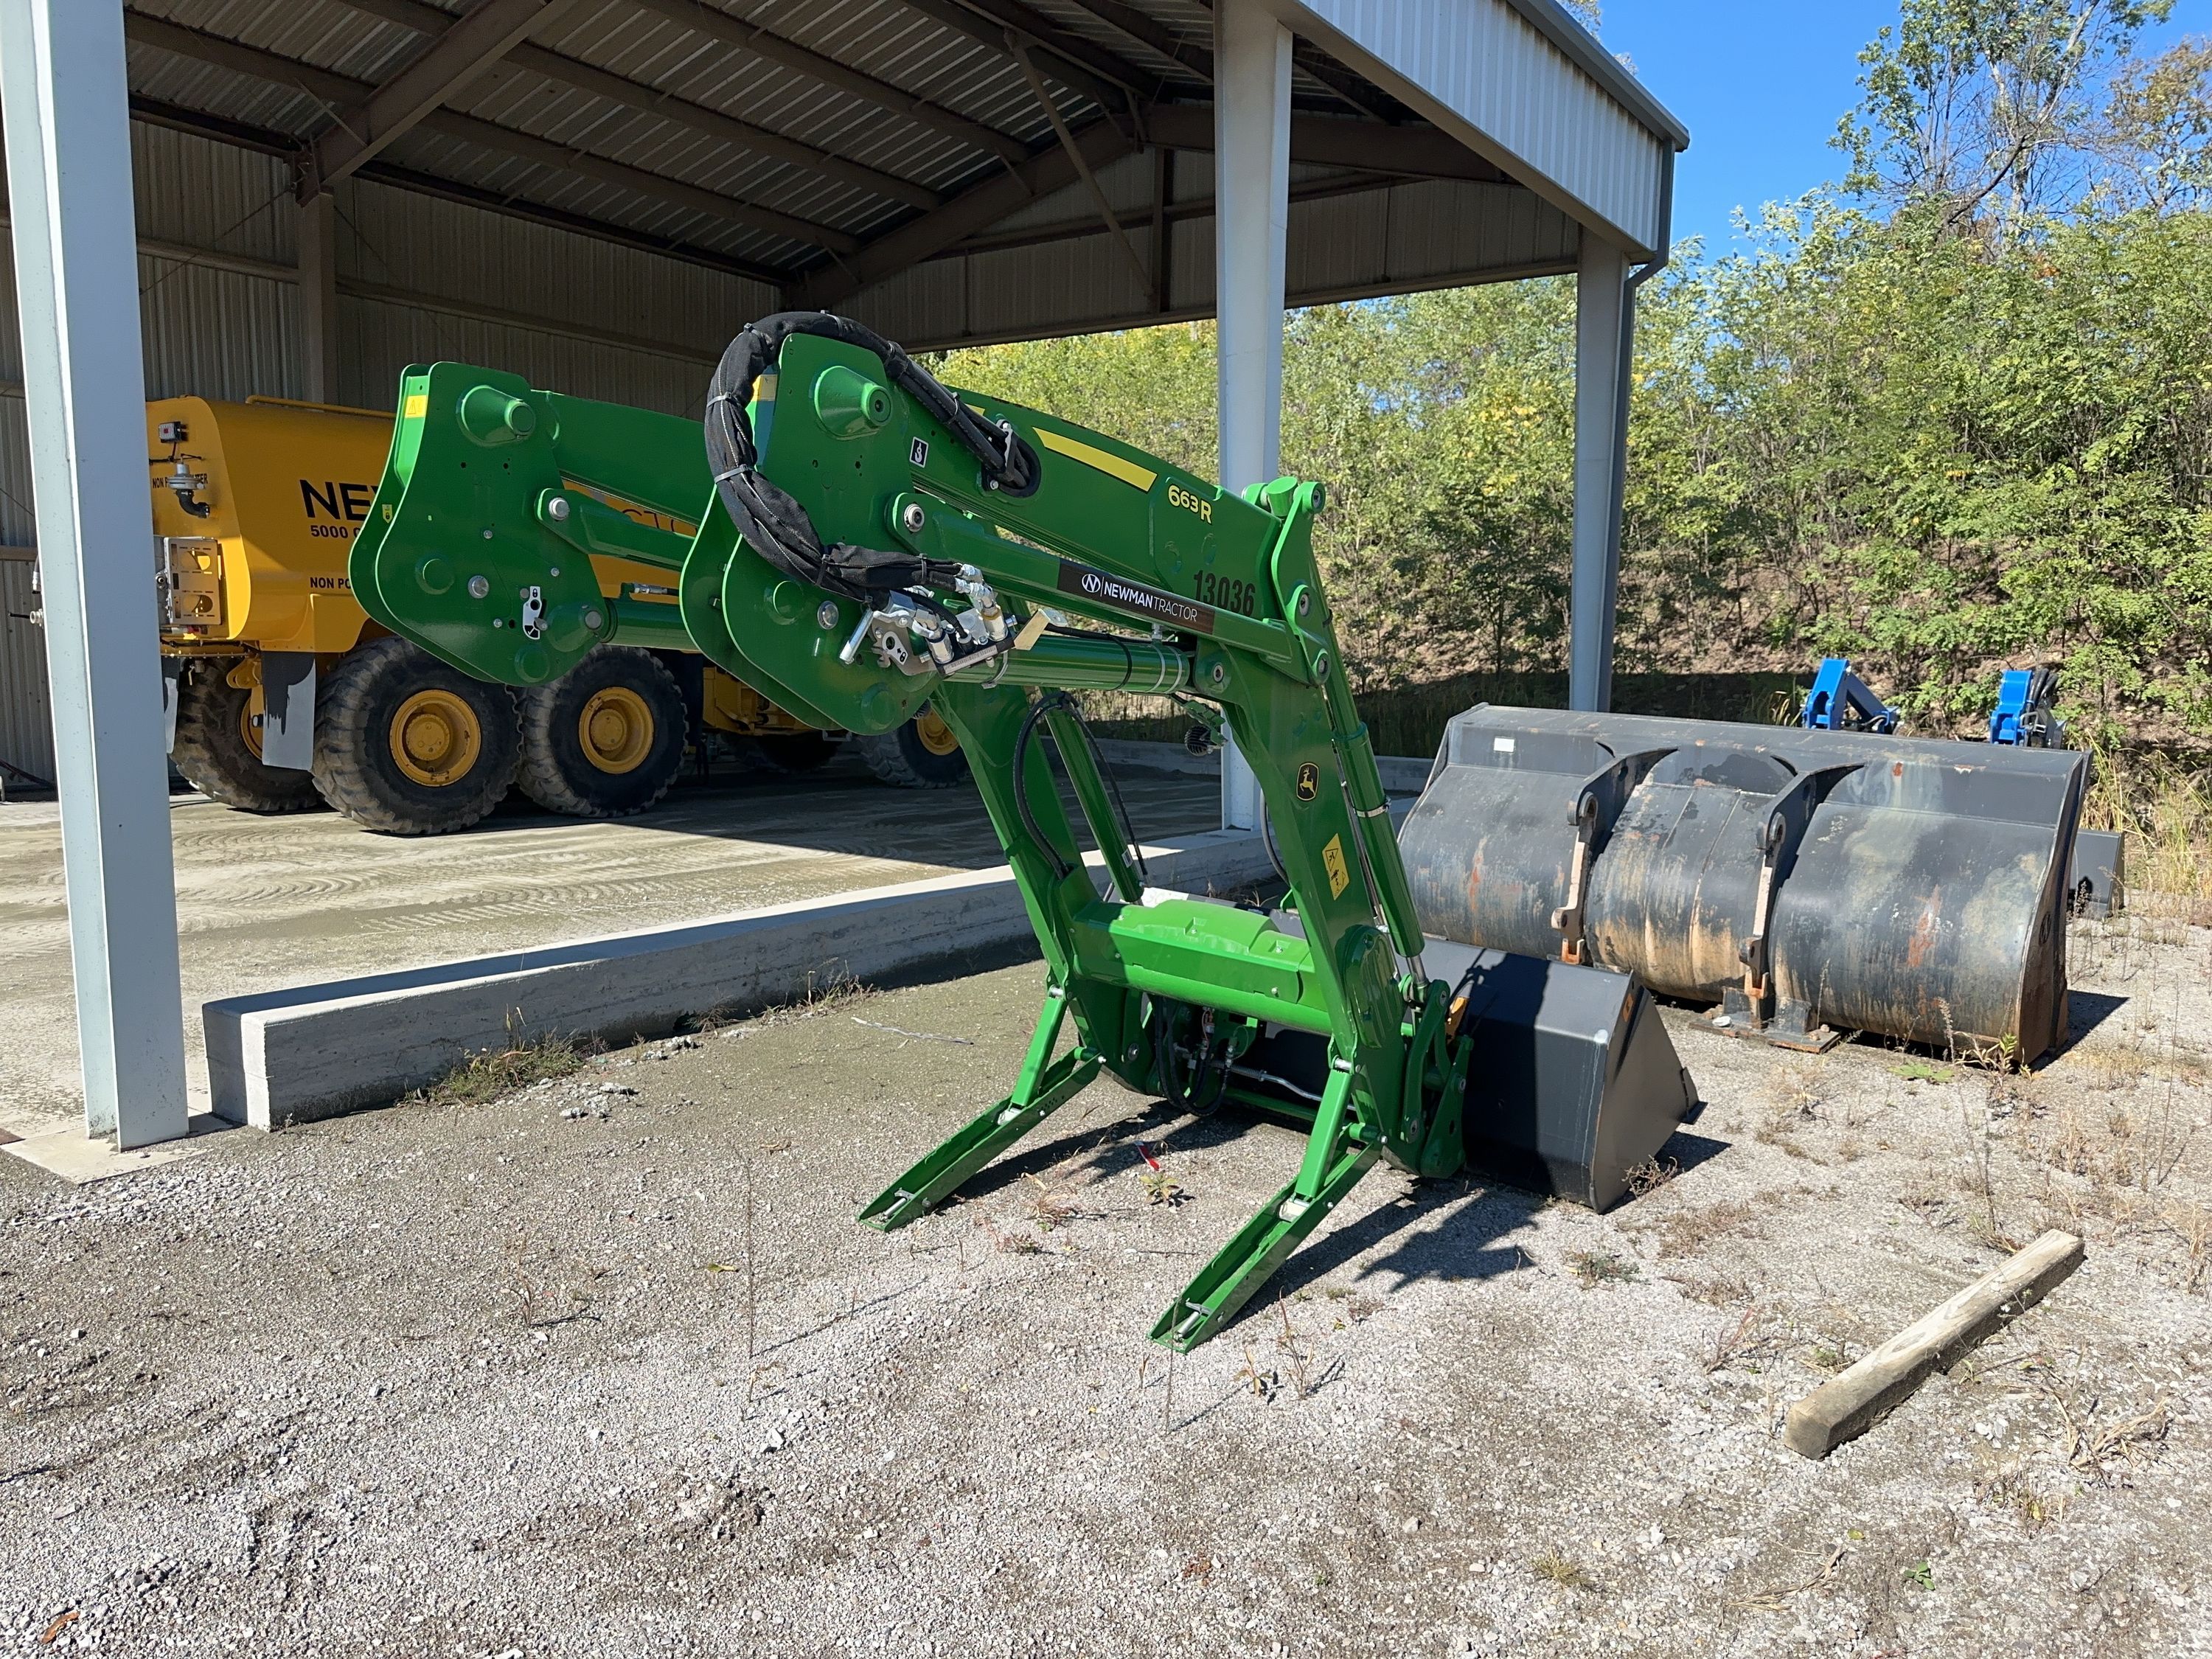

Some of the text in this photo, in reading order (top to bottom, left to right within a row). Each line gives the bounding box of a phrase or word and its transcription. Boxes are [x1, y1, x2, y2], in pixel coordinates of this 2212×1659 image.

[310, 525, 348, 538] 5000
[310, 577, 335, 588] NON
[1194, 570, 1255, 616] 13036
